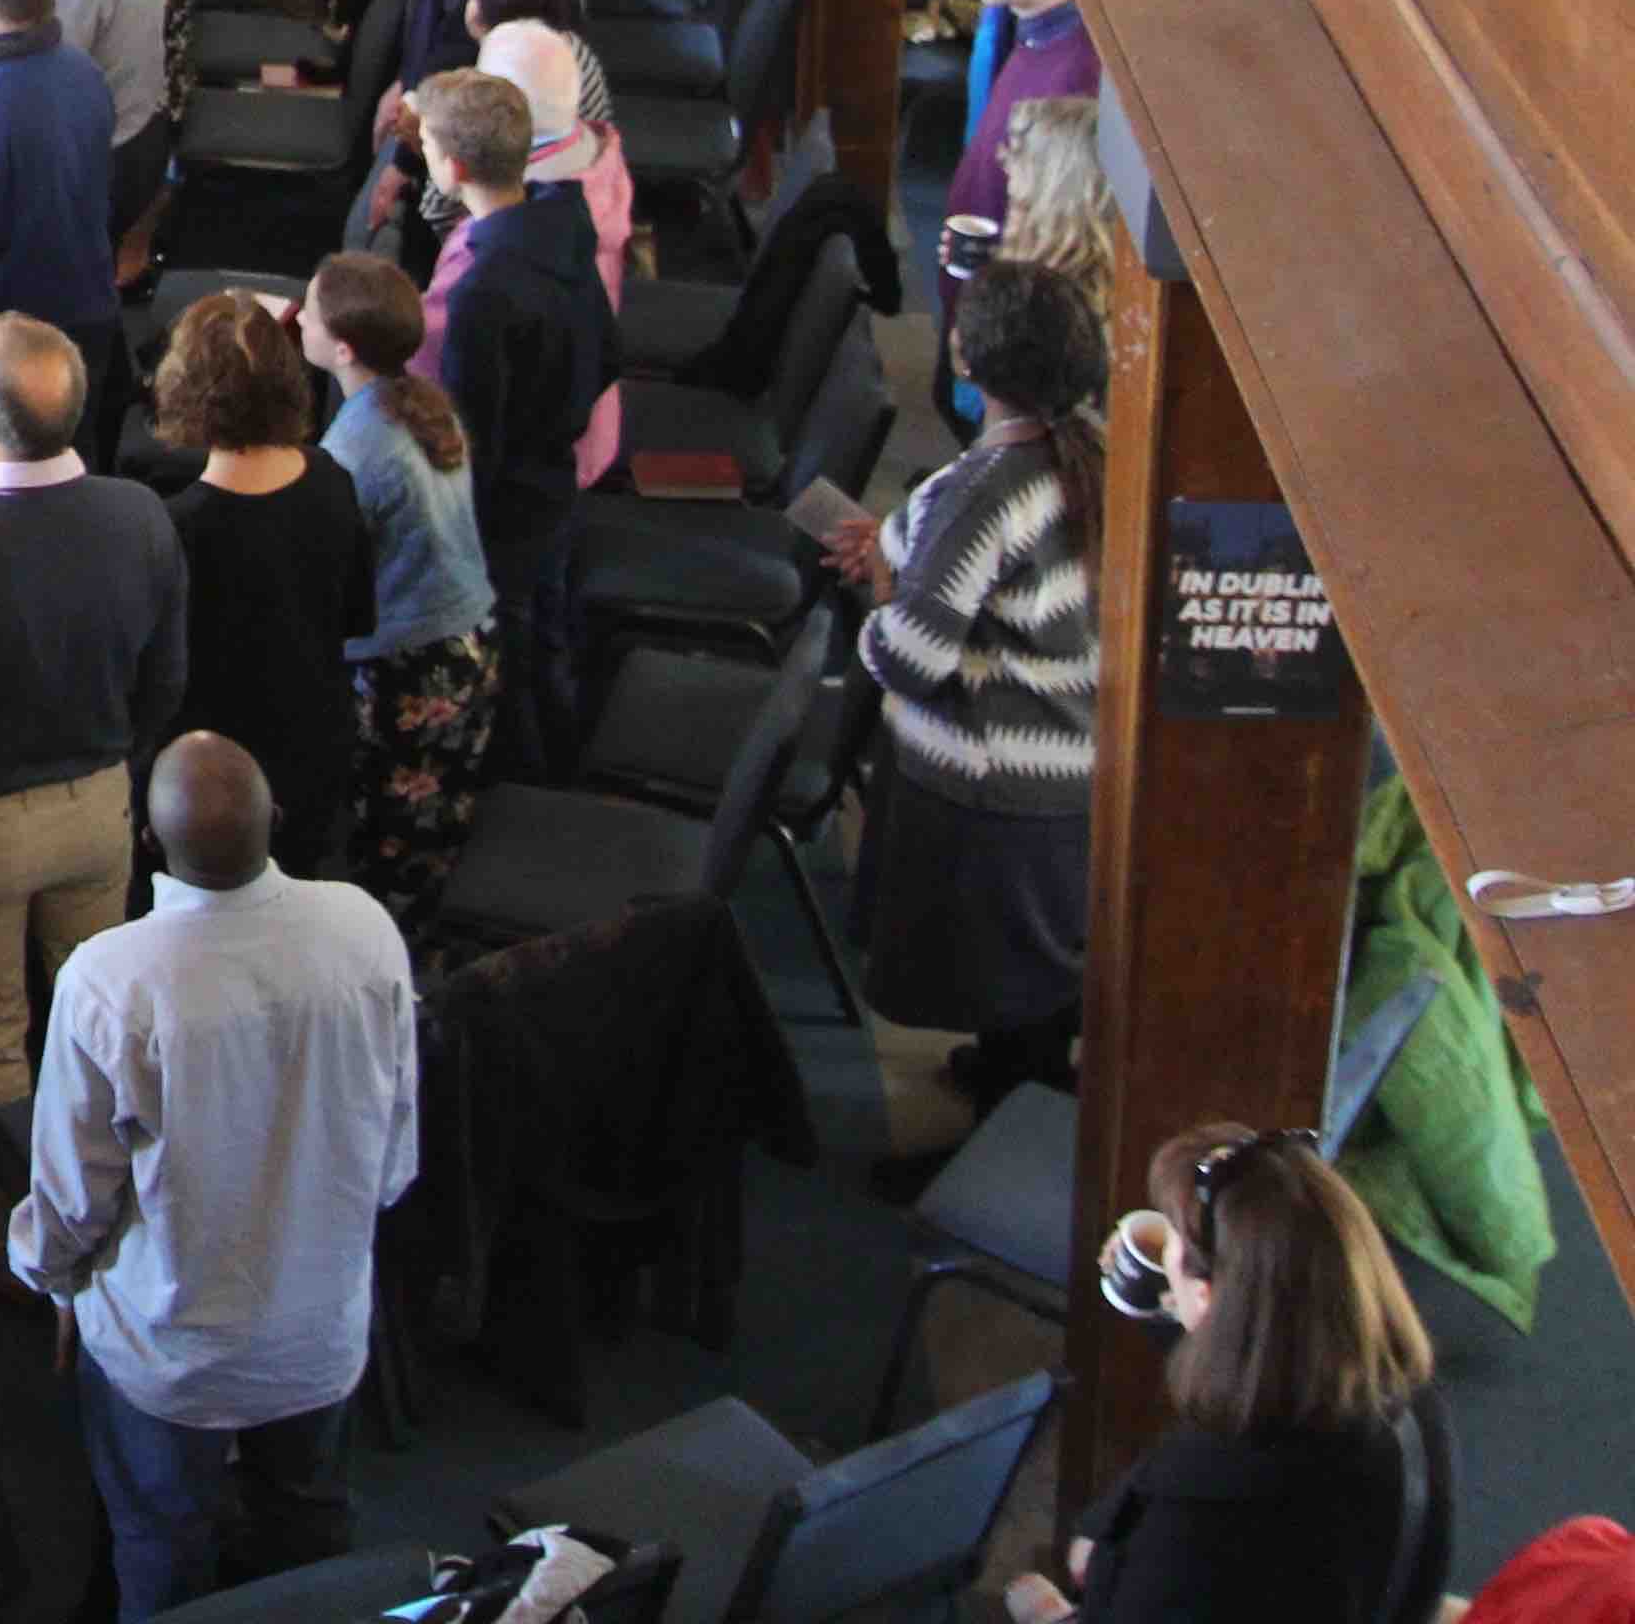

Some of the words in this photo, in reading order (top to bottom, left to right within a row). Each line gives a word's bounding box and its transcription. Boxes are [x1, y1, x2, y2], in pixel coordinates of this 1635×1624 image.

[1178, 571, 1213, 595] IN
[1178, 598, 1224, 622] AS
[1229, 599, 1260, 624] IT
[1261, 600, 1292, 624] IS
[1296, 600, 1330, 625] IN
[1190, 625, 1319, 652] HEAVEN
